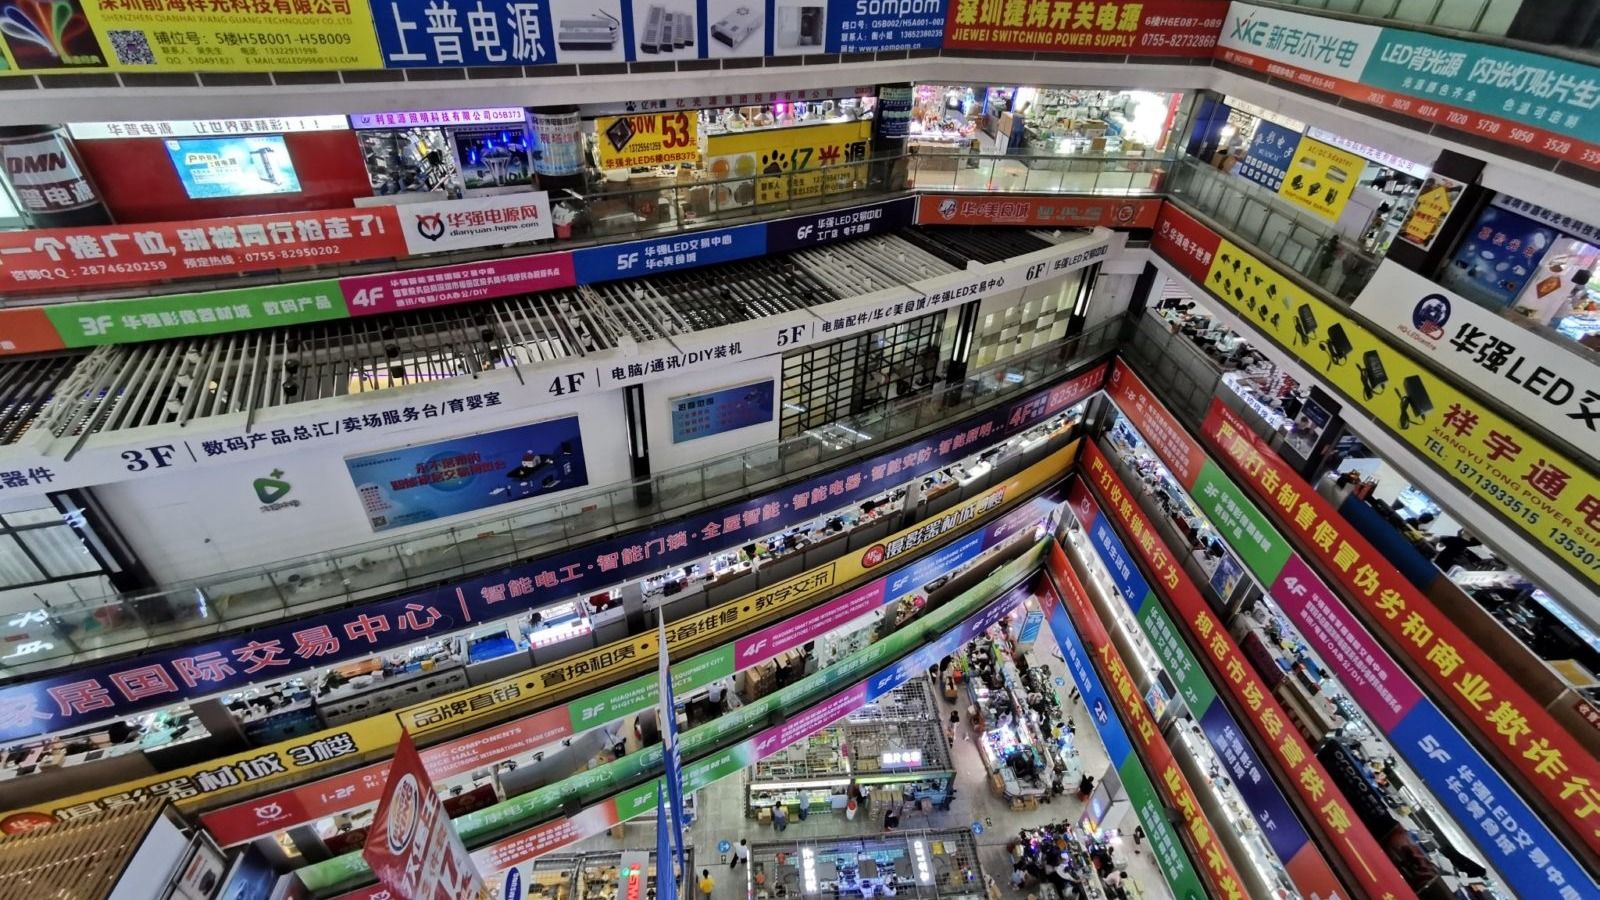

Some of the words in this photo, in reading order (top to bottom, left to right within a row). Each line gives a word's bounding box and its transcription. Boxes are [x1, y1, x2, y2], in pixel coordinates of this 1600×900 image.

[955, 0, 1141, 33] 深圳捷炜开关电源
[390, 2, 546, 64] 上普电源
[991, 29, 1052, 43] SWITCHING
[1054, 33, 1091, 45] POWER
[1094, 34, 1137, 47] SUPPLY
[1141, 33, 1217, 48] 0755-82732866
[1265, 25, 1359, 69] 新克尔光电
[1380, 42, 1467, 78] LED背光源
[1417, 102, 1440, 118] 4014
[1446, 107, 1469, 125] 7020
[107, 123, 174, 136] 华普电源
[661, 114, 691, 149] 53
[606, 151, 696, 168] 华强北LED5楼Q5B375
[447, 204, 538, 228] 华强电源网
[796, 225, 814, 240] 6F
[616, 251, 639, 271] 5F
[645, 233, 732, 257] 华强LED交易中心
[1169, 226, 1212, 266] 华强电子世界
[1026, 262, 1046, 282] 6F
[352, 287, 384, 308] 4F
[79, 314, 115, 337] 3F
[121, 303, 252, 331] 华强影像器材城
[263, 293, 333, 317] 数码产品
[777, 324, 806, 347] 5F
[549, 372, 586, 397] 4F
[612, 342, 742, 381] 电脑/通讯/DIY装机
[121, 443, 177, 473] 3F
[202, 391, 503, 457] 数码产品总汇/卖场服务台/育婴室
[1431, 426, 1484, 465] XIANGYU
[1485, 463, 1521, 491] TONG
[1521, 488, 1573, 528] POWER
[1203, 481, 1220, 499] 3F
[1454, 458, 1541, 525] 13713933515
[892, 574, 910, 593] 5F
[1283, 576, 1308, 597] 4F
[742, 640, 768, 659] 4F
[877, 672, 894, 690] 5F
[611, 695, 646, 712] DIGITAL
[1184, 685, 1199, 706] 2F
[582, 703, 606, 722] 3F
[1094, 701, 1109, 727] 2F
[289, 733, 358, 767] 3楼
[450, 727, 523, 756] COMPONENTS
[757, 733, 777, 752] 4F
[1417, 734, 1452, 764] 5F
[454, 748, 479, 762] HALL
[632, 790, 653, 808] 3F
[1259, 809, 1277, 832] 3F
